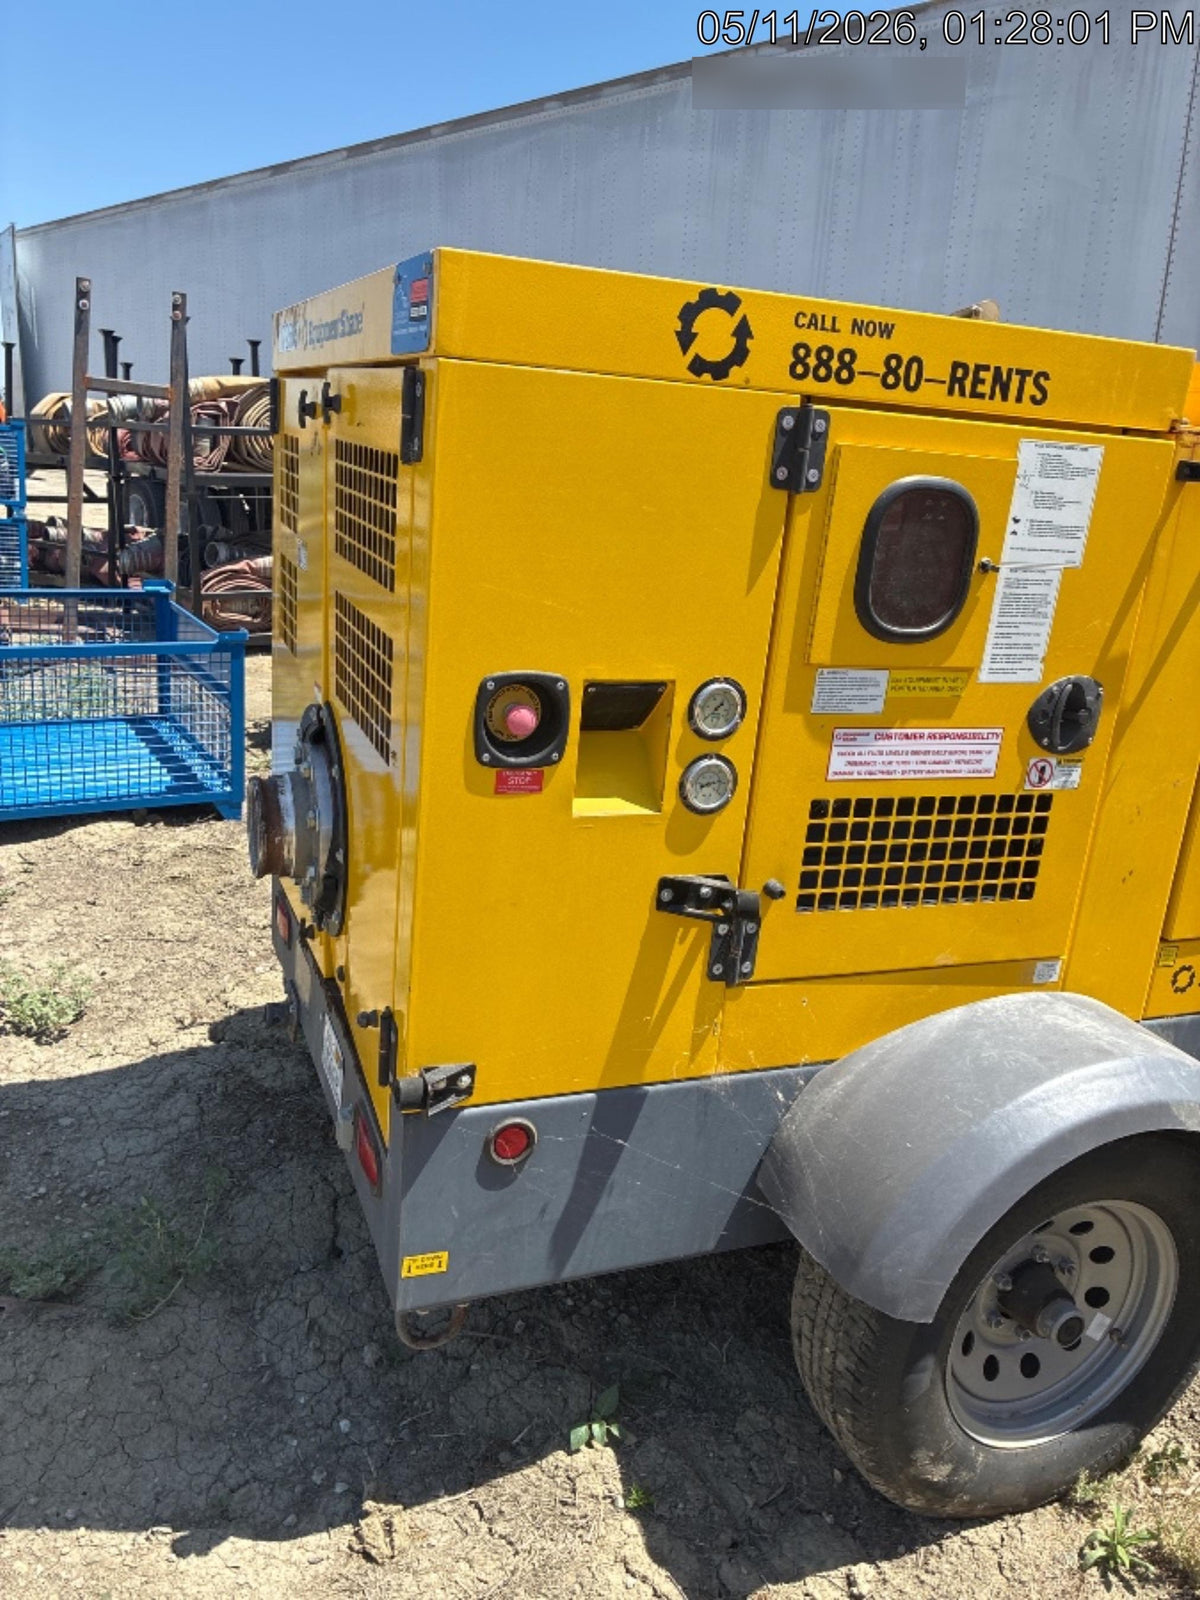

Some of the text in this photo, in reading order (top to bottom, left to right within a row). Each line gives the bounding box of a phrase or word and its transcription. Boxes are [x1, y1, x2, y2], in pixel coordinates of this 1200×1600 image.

[794, 311, 895, 340] CALL NOW
[874, 731, 925, 741] CUSTOMER
[927, 731, 1001, 741] RESPONSIBILITY
